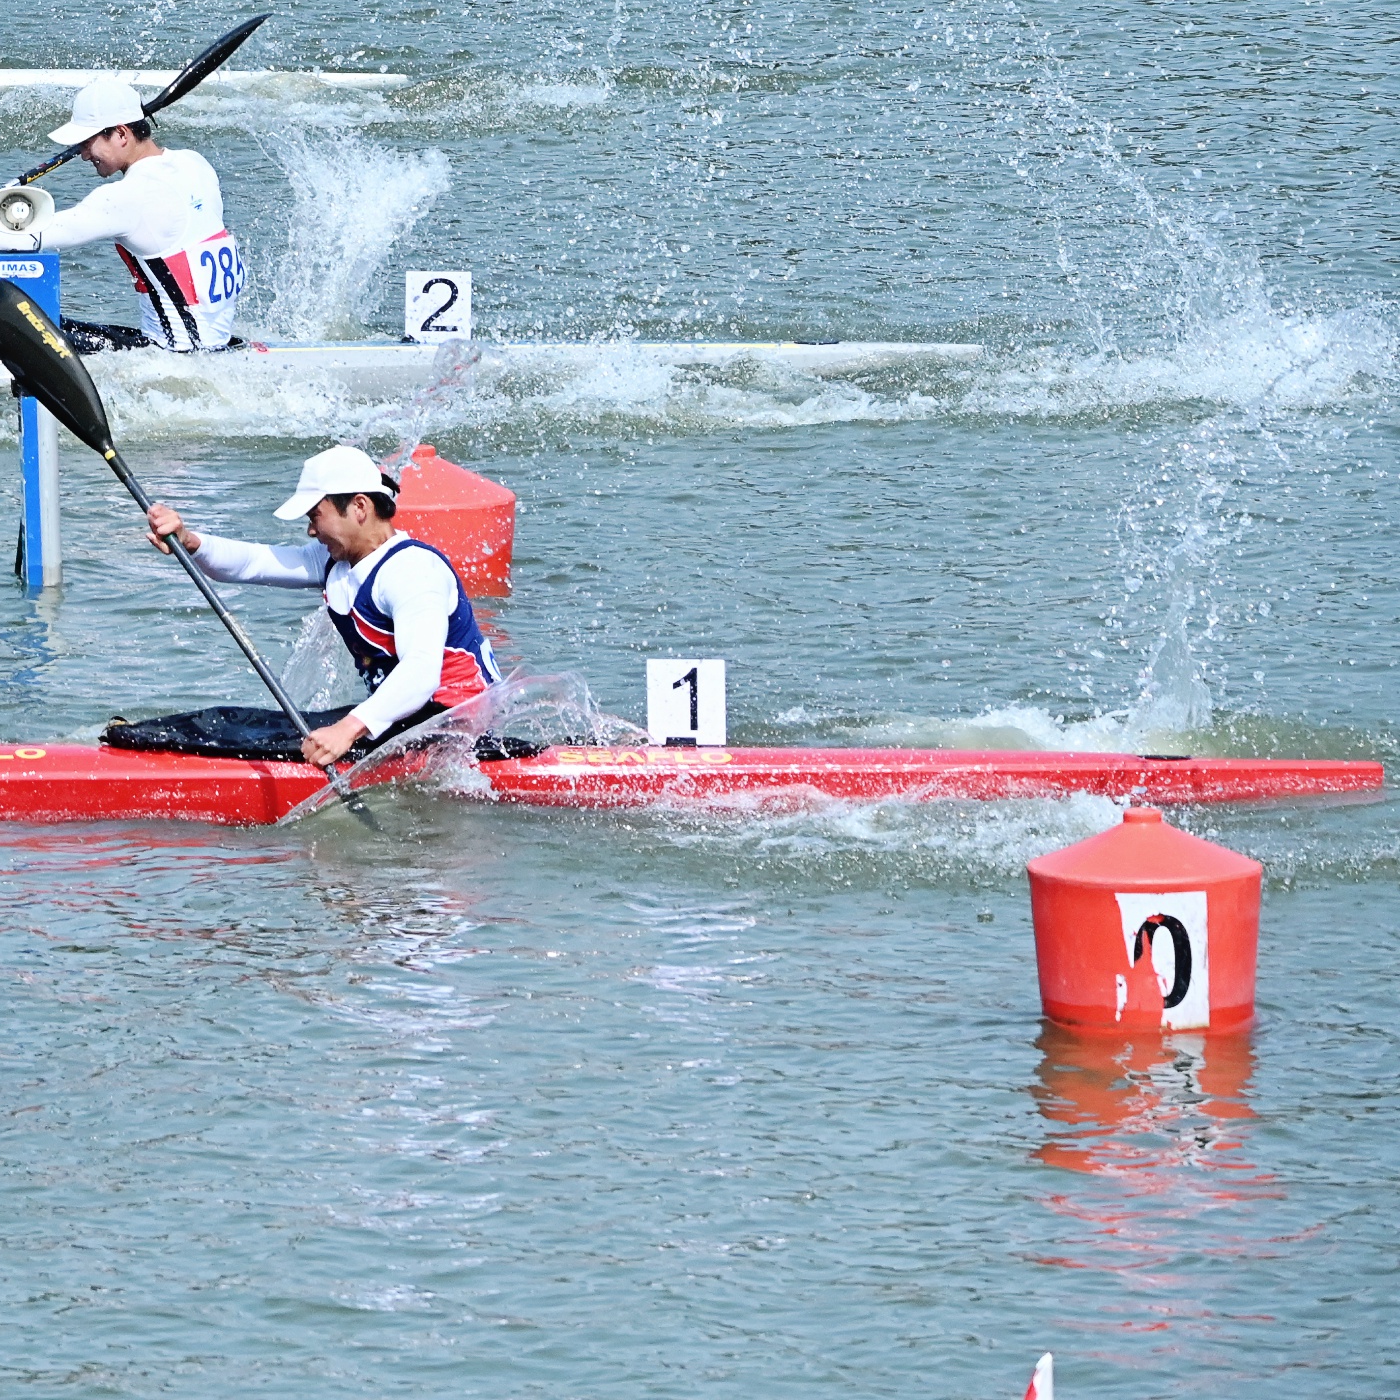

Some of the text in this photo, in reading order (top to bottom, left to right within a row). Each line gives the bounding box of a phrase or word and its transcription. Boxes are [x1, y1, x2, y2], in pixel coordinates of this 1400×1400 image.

[2, 263, 37, 272] IMAS
[421, 277, 459, 332] 2
[672, 667, 698, 731] 1
[557, 750, 733, 764] SEAFLO
[1133, 912, 1193, 1009] 0
